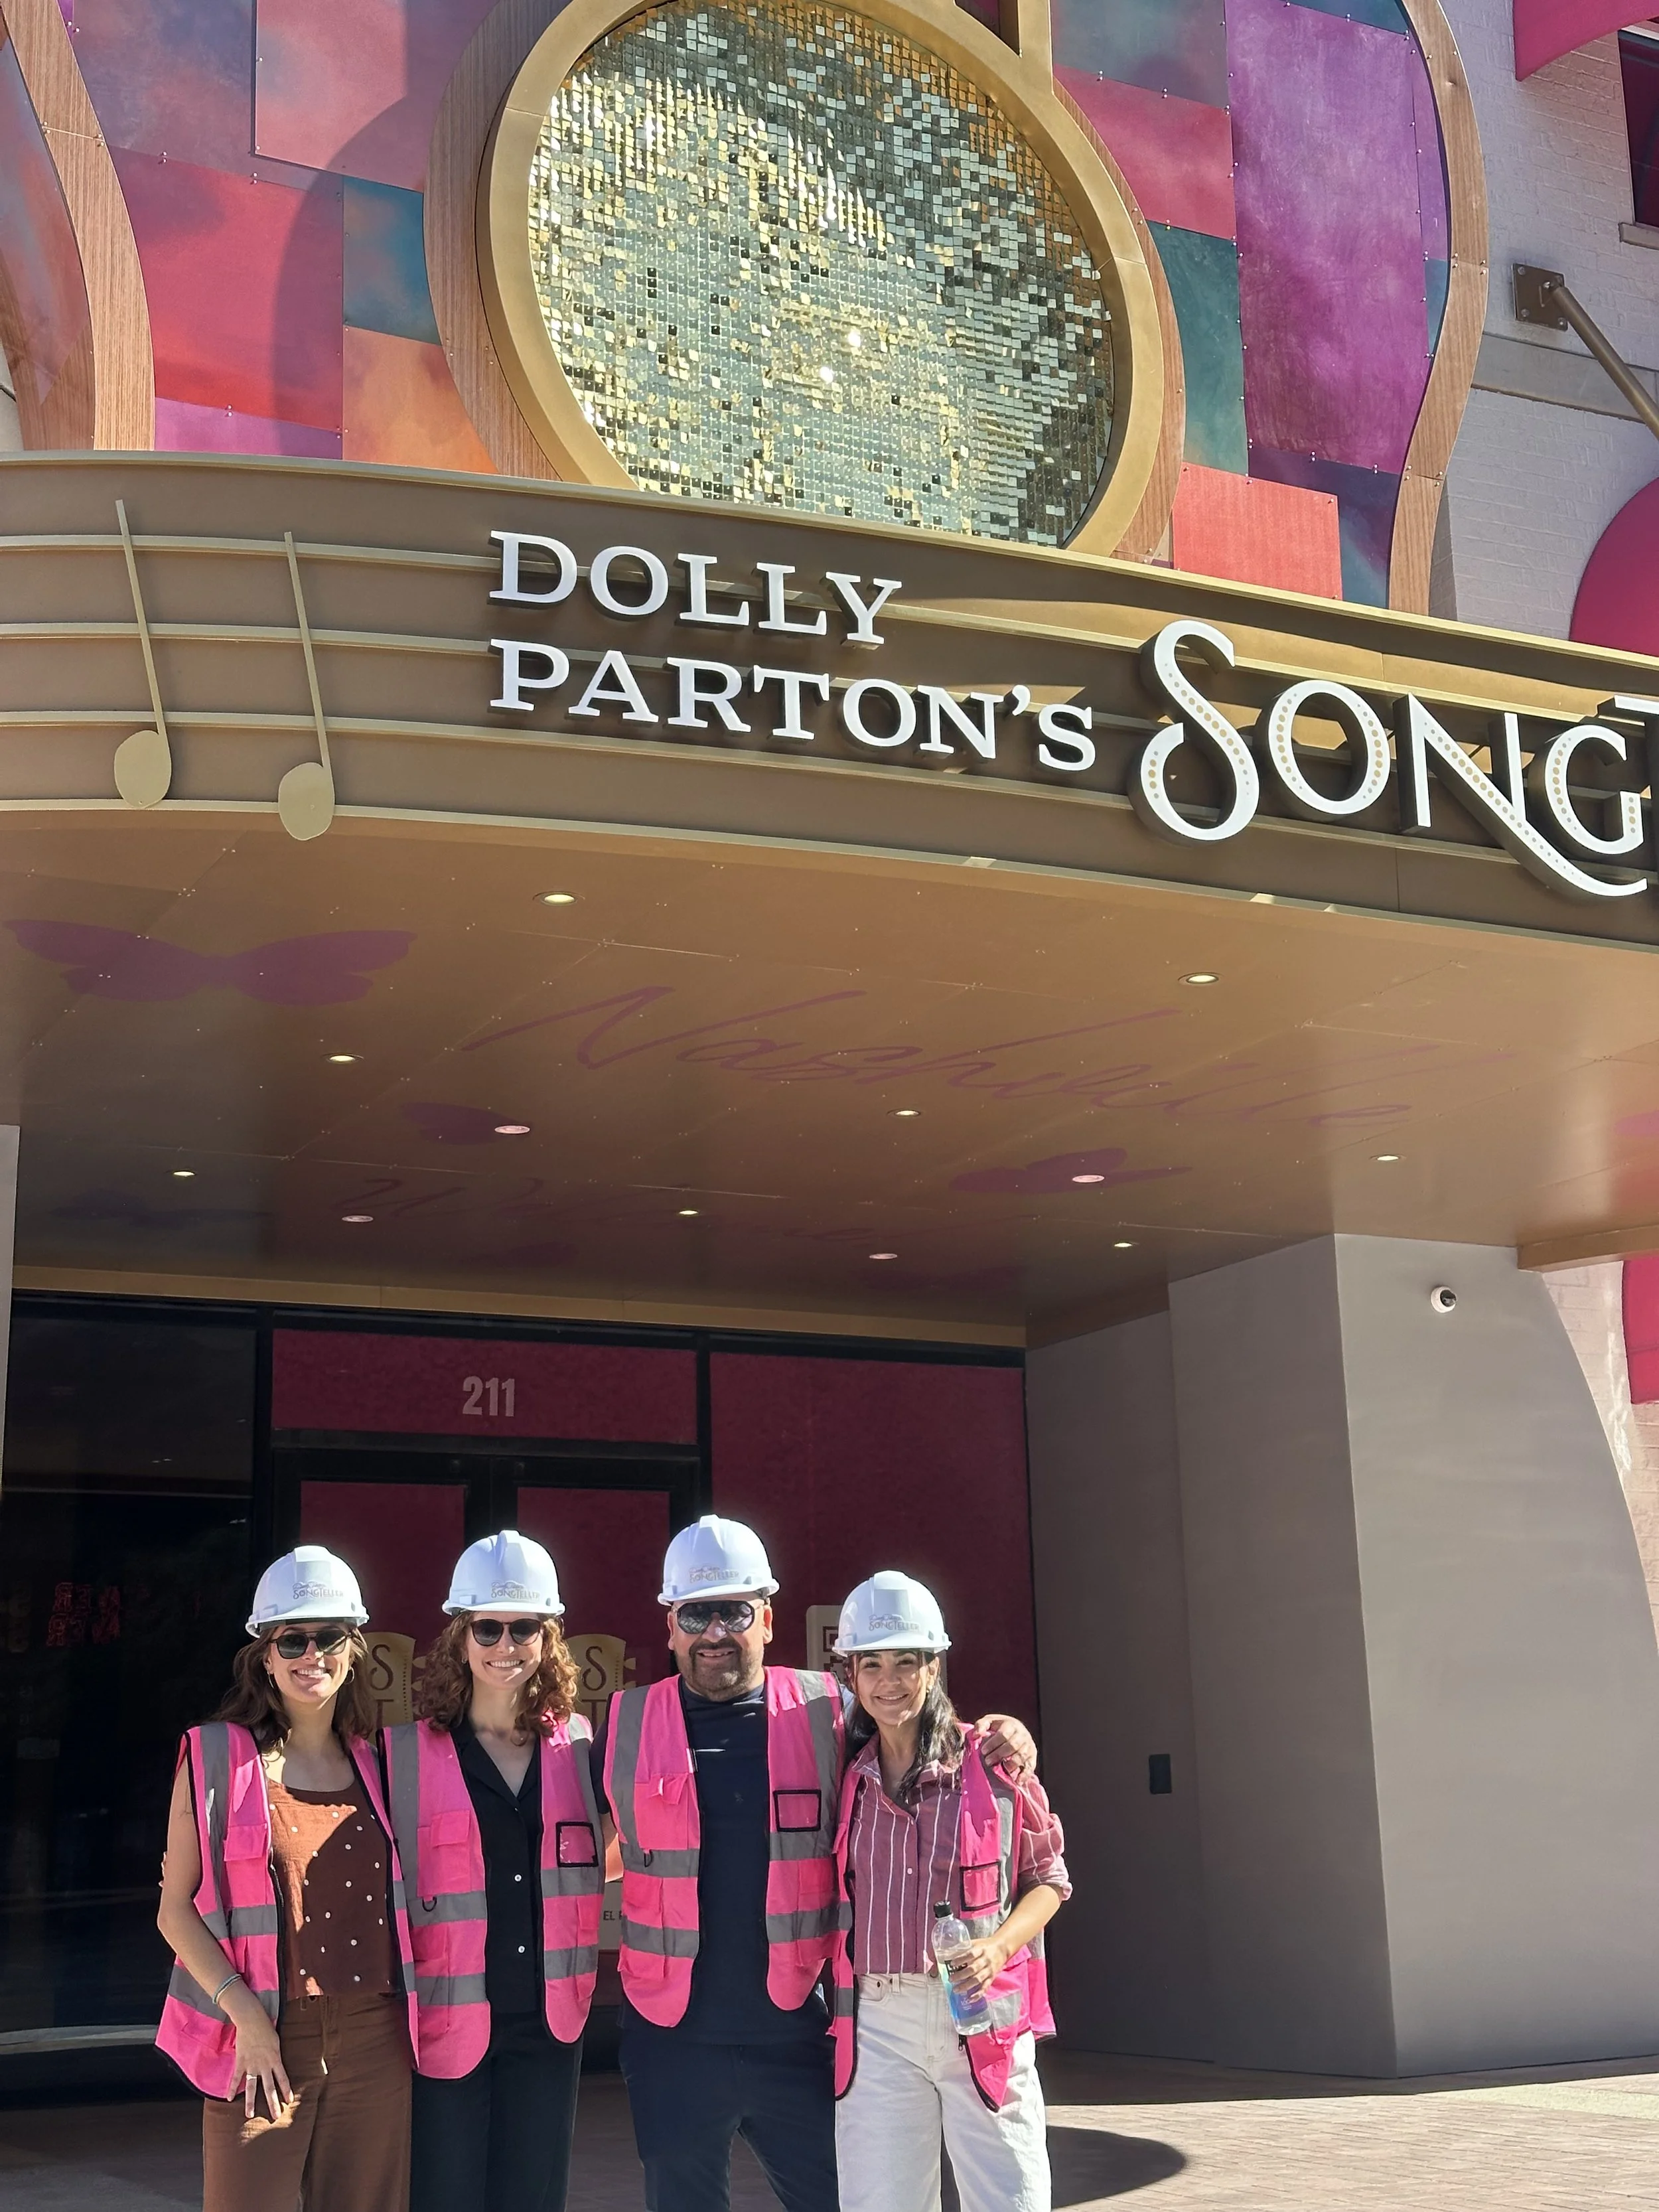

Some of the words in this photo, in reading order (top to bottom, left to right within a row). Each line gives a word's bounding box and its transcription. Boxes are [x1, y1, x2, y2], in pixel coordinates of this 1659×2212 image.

[490, 530, 902, 646] DOLLY
[490, 638, 1096, 771] PARTON'S
[1140, 619, 1659, 897] SONG
[463, 1375, 515, 1417] 211
[370, 1644, 394, 1691] S
[582, 1646, 607, 1691] S
